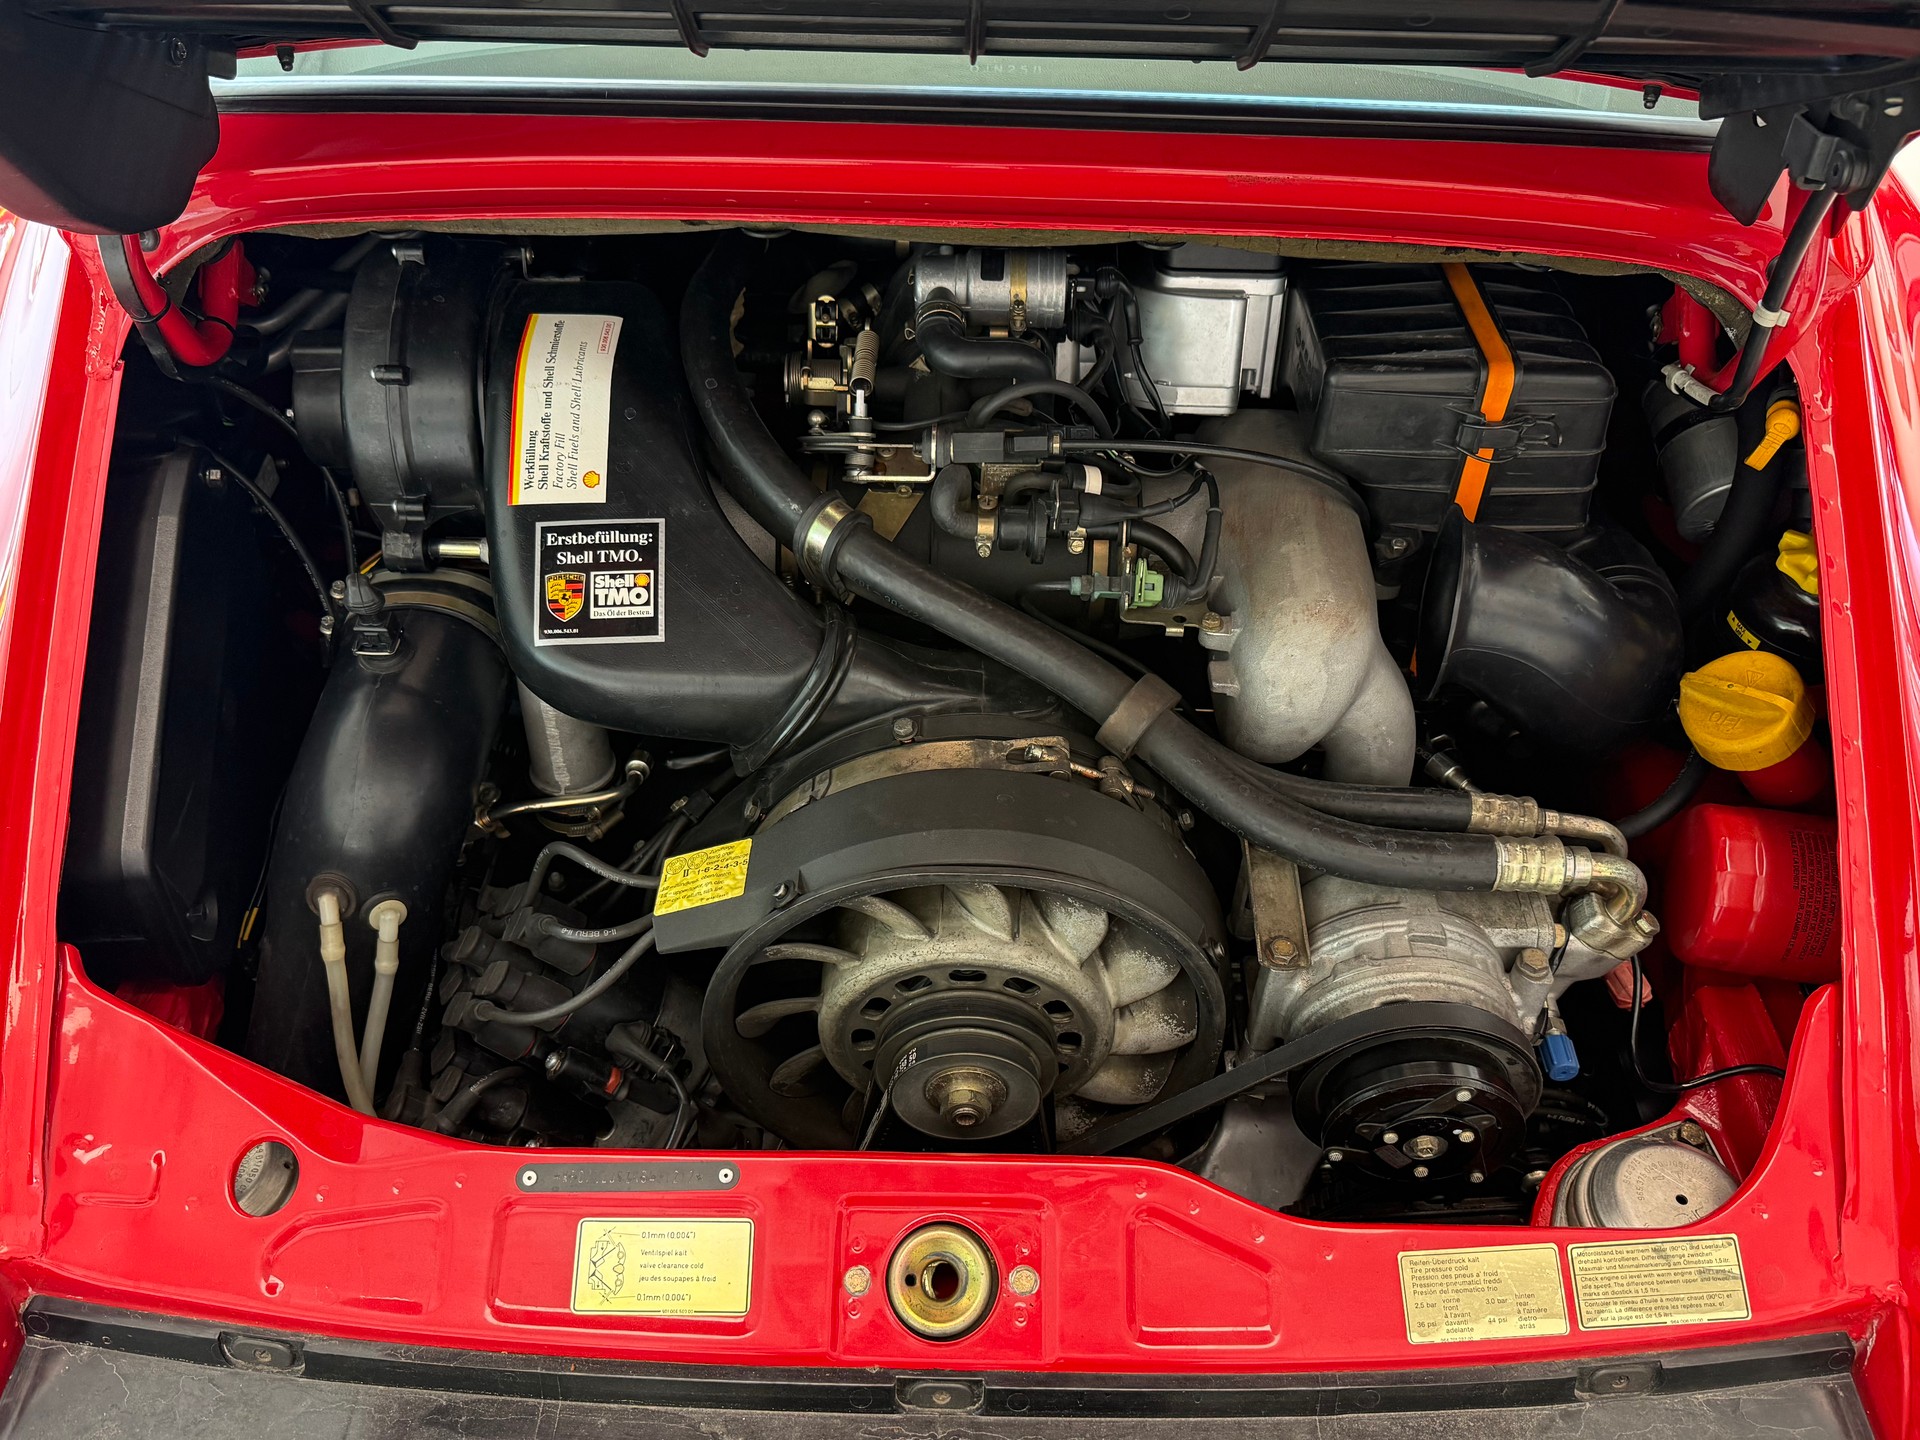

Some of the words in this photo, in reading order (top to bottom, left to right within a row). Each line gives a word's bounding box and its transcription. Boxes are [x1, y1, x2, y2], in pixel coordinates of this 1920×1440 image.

[546, 320, 565, 364] Schmierstoffe
[572, 341, 587, 382] Lubricants
[543, 366, 555, 388] Shell
[543, 392, 553, 409] und
[570, 386, 581, 410] Shell
[570, 414, 580, 432] and
[539, 413, 552, 461] Kraftstoffe
[555, 433, 565, 449] Fill
[568, 435, 579, 461] Fuels
[524, 431, 538, 490] Werkfüllung
[538, 465, 549, 490] Shell
[553, 452, 565, 489] Factory
[567, 464, 578, 489] Shell
[547, 531, 653, 546] Erstbefüllung:
[557, 551, 593, 564] Shell
[597, 549, 642, 563] TMO.
[595, 574, 634, 588] Shell
[595, 587, 648, 606] TMO
[698, 859, 748, 875] 1-6-2-4-3-5
[575, 929, 600, 937] BERU
[1409, 1258, 1466, 1266] Reifen-Überdruck
[1425, 1266, 1452, 1274] pressure
